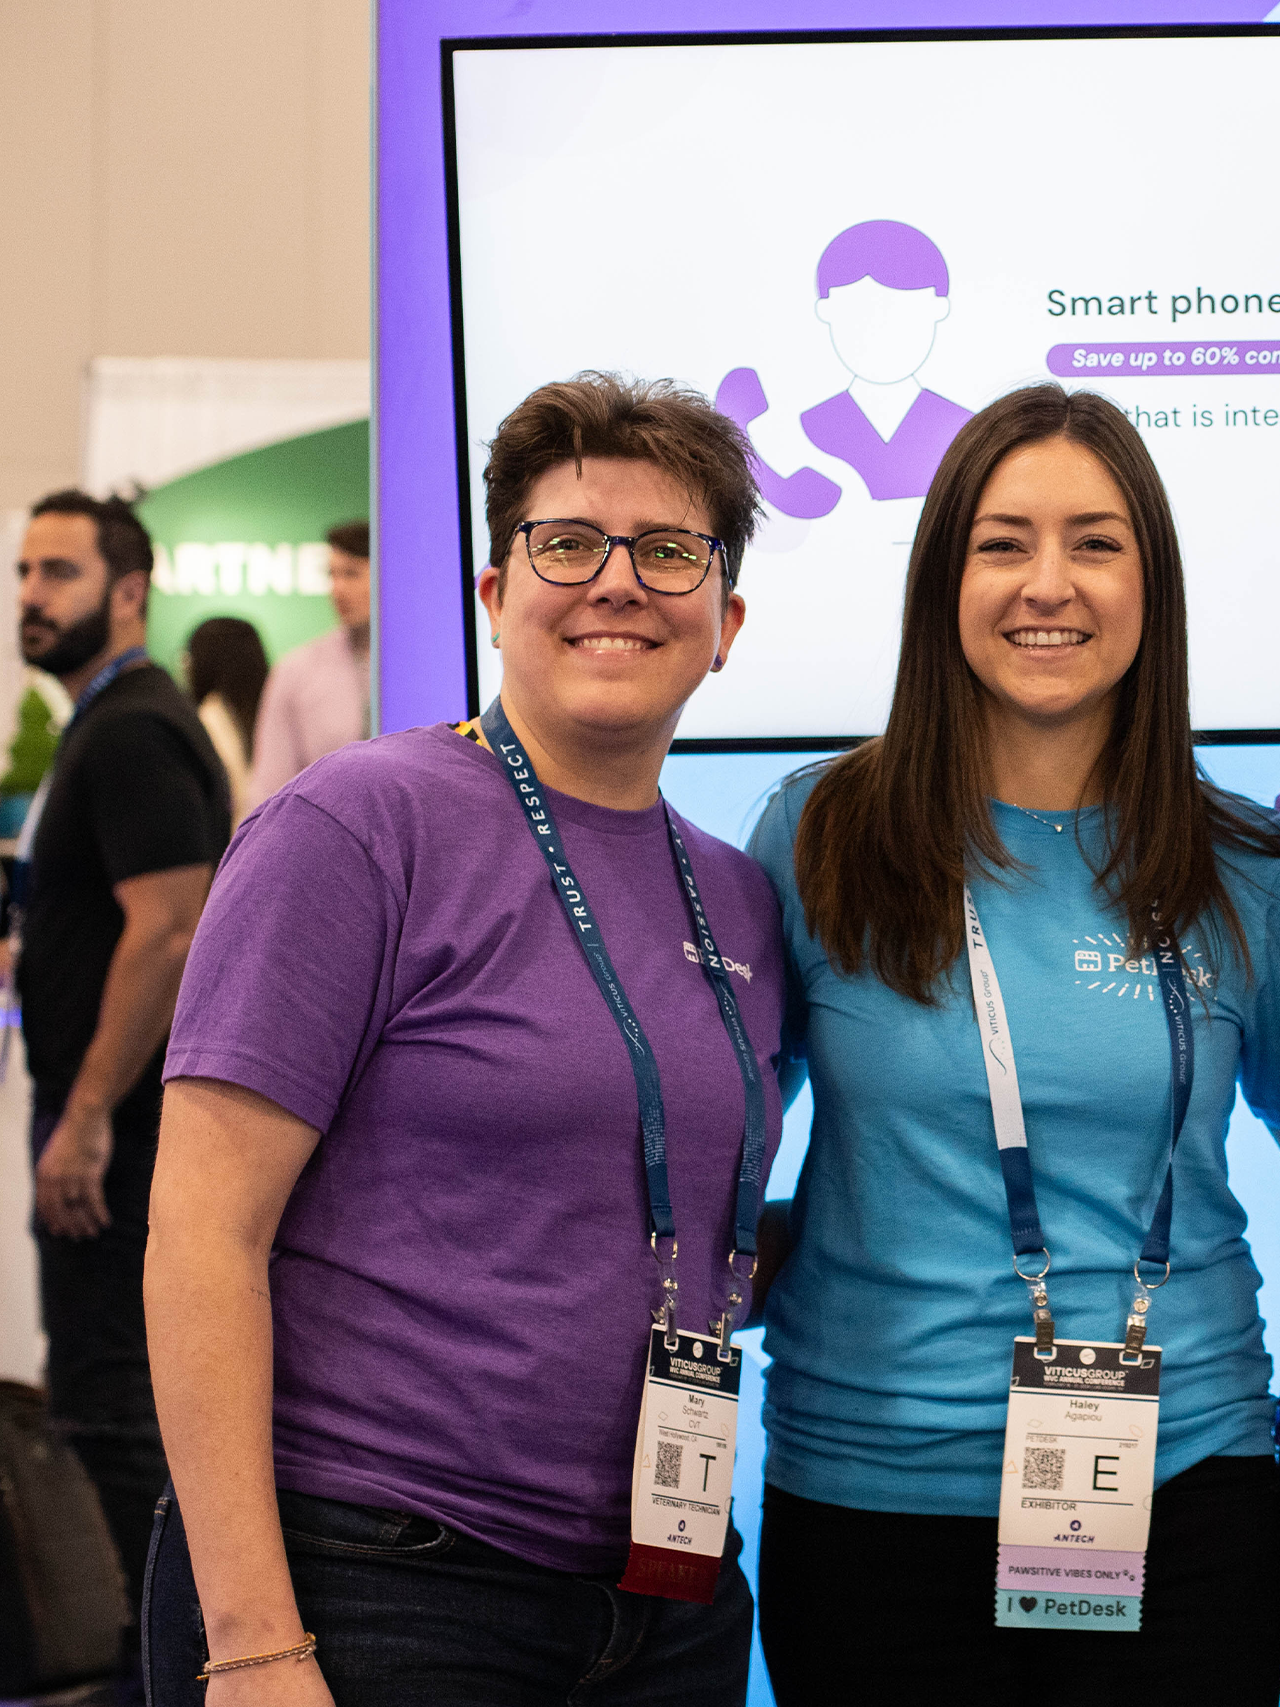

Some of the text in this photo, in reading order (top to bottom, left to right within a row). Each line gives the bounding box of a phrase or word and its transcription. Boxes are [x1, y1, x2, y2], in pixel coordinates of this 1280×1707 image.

[1047, 289, 1158, 316] Smart
[1072, 348, 1125, 368] Save
[1129, 350, 1158, 371] up
[1163, 349, 1186, 367] to
[1190, 346, 1240, 366] 60%
[1192, 403, 1214, 428] is
[151, 541, 334, 597] ARTNE
[500, 743, 551, 835] RESPECT
[553, 862, 592, 932] TRUST
[685, 874, 720, 968] PASSION
[608, 982, 628, 1018] VITICUS
[980, 969, 999, 1036] VITICUS Group
[1175, 1015, 1187, 1051] VITICUS
[669, 1356, 721, 1376] VITICUSGROUP
[1044, 1366, 1126, 1380] VITICUSGROUP
[1058, 1376, 1084, 1384] ANNUAL
[1084, 1377, 1126, 1387] CONFERENCE
[688, 1394, 705, 1408] Mary
[1069, 1399, 1100, 1412] Haley
[688, 1419, 701, 1429] CVT
[1064, 1411, 1103, 1423] Agapiou
[699, 1453, 716, 1492] T
[1092, 1455, 1119, 1492] E
[652, 1496, 720, 1516] VETERINARY TECHNICIAN
[1021, 1500, 1077, 1512] EXHIBITOR
[667, 1533, 693, 1545] ANTECH
[1053, 1533, 1095, 1544] ANTECH
[1008, 1565, 1121, 1581] PAWSITIVE VIBES ONLY
[1007, 1597, 1126, 1617] I PetDesk
